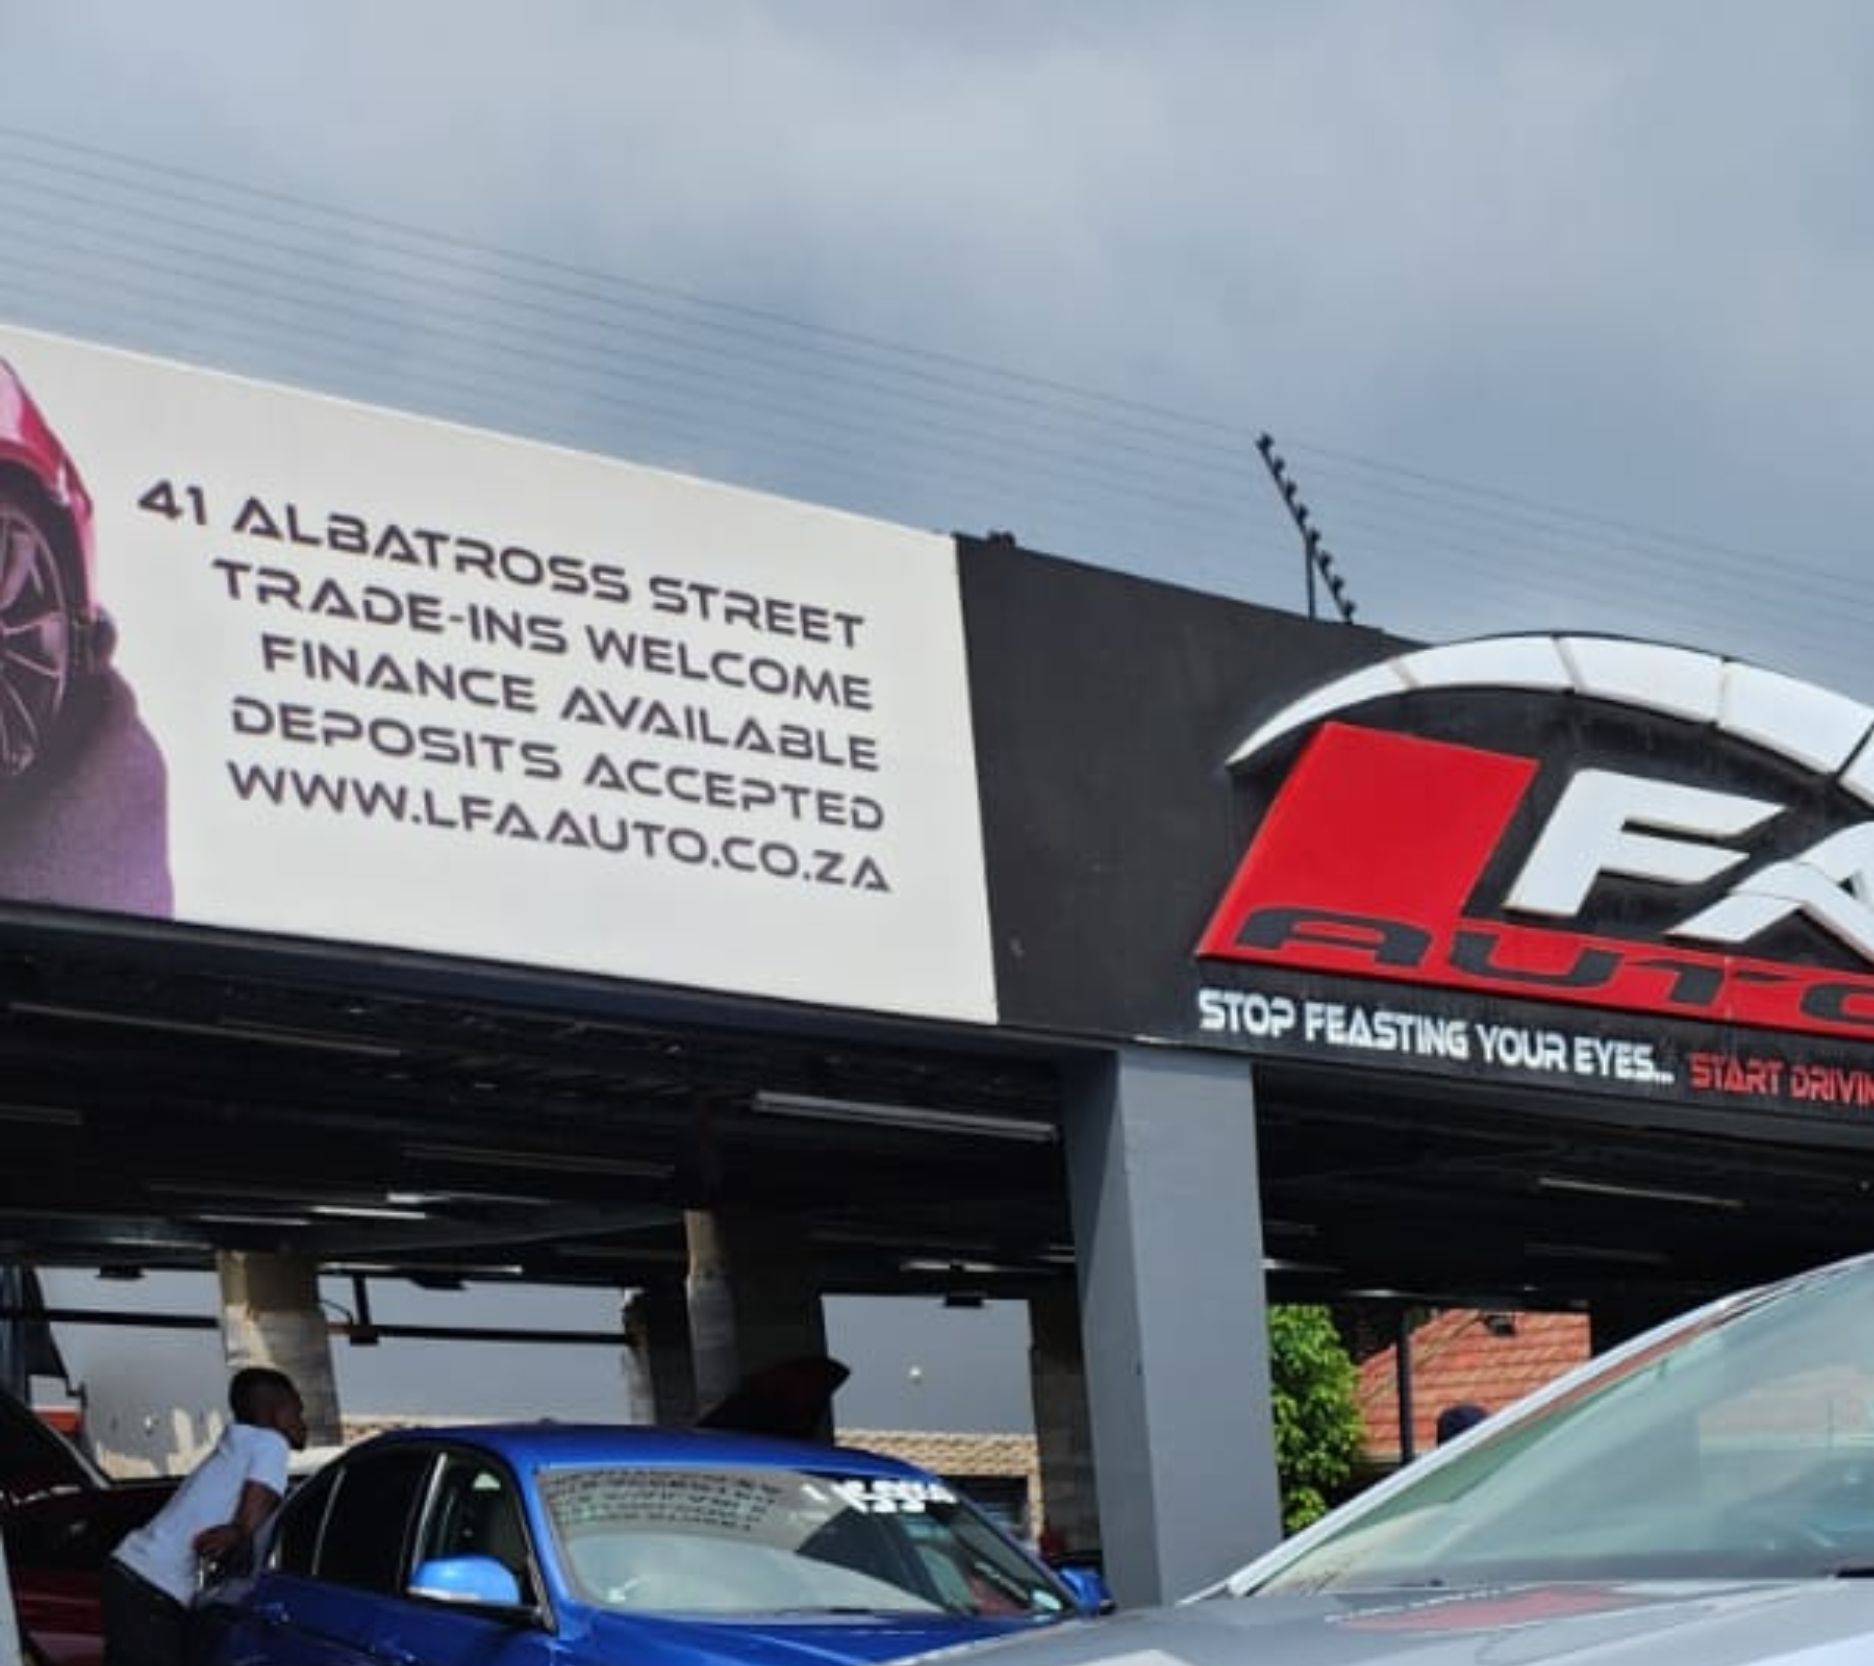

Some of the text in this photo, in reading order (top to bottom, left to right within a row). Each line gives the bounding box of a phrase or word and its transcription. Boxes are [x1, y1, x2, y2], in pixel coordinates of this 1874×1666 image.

[137, 480, 864, 649] 41 ALBATROSS STREET
[212, 558, 872, 711] TRADE-INS WELCOME
[232, 696, 884, 831] DEPOSITS ACCEPTED
[261, 633, 879, 772] FINANCE AVAILABLE
[225, 760, 892, 894] WWW.LFAAUTO.CO.ZA
[1198, 988, 1676, 1085] STOP FEASTING YOUR EYES...
[1691, 1052, 1782, 1097] START
